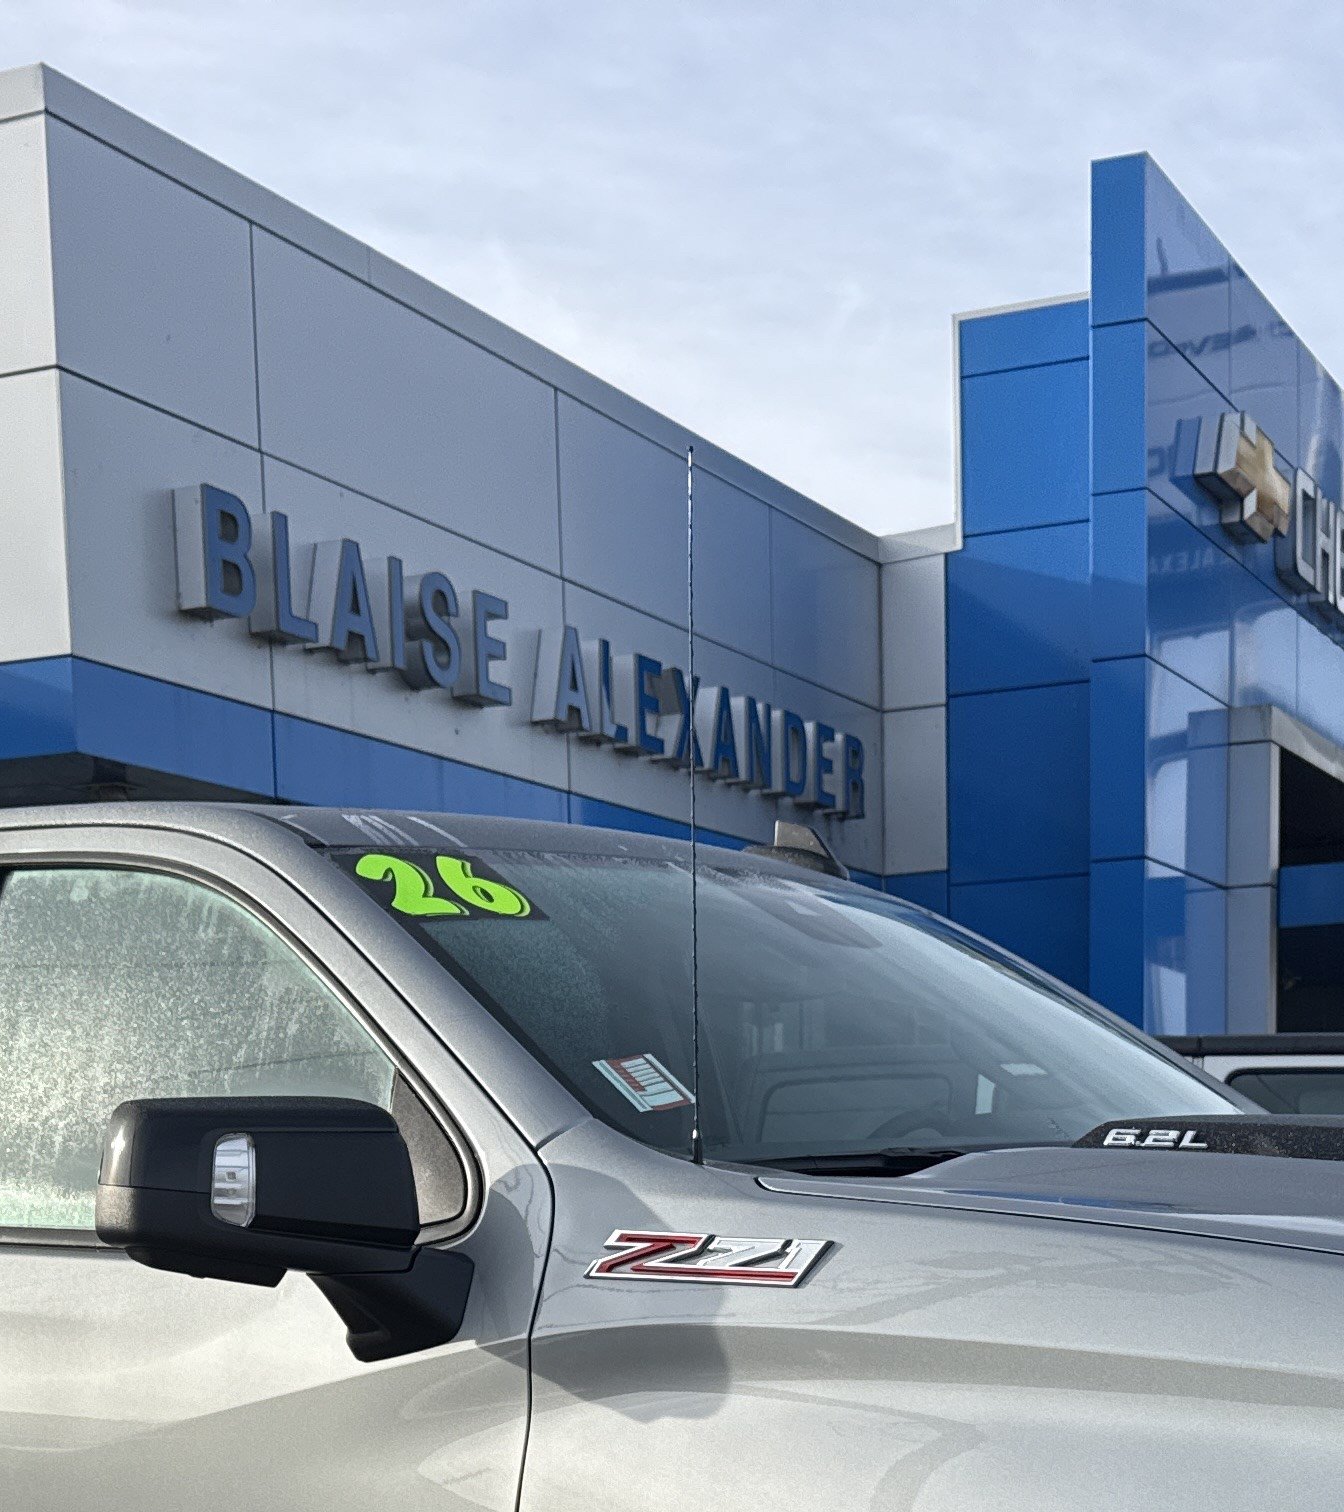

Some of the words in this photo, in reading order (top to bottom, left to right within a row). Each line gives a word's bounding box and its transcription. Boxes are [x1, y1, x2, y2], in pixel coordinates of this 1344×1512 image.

[196, 482, 513, 708] BLAISE
[551, 625, 866, 820] ALEXANDER
[355, 853, 532, 917] 26
[1102, 1127, 1209, 1149] 6.2L
[584, 1228, 837, 1288] Z71
